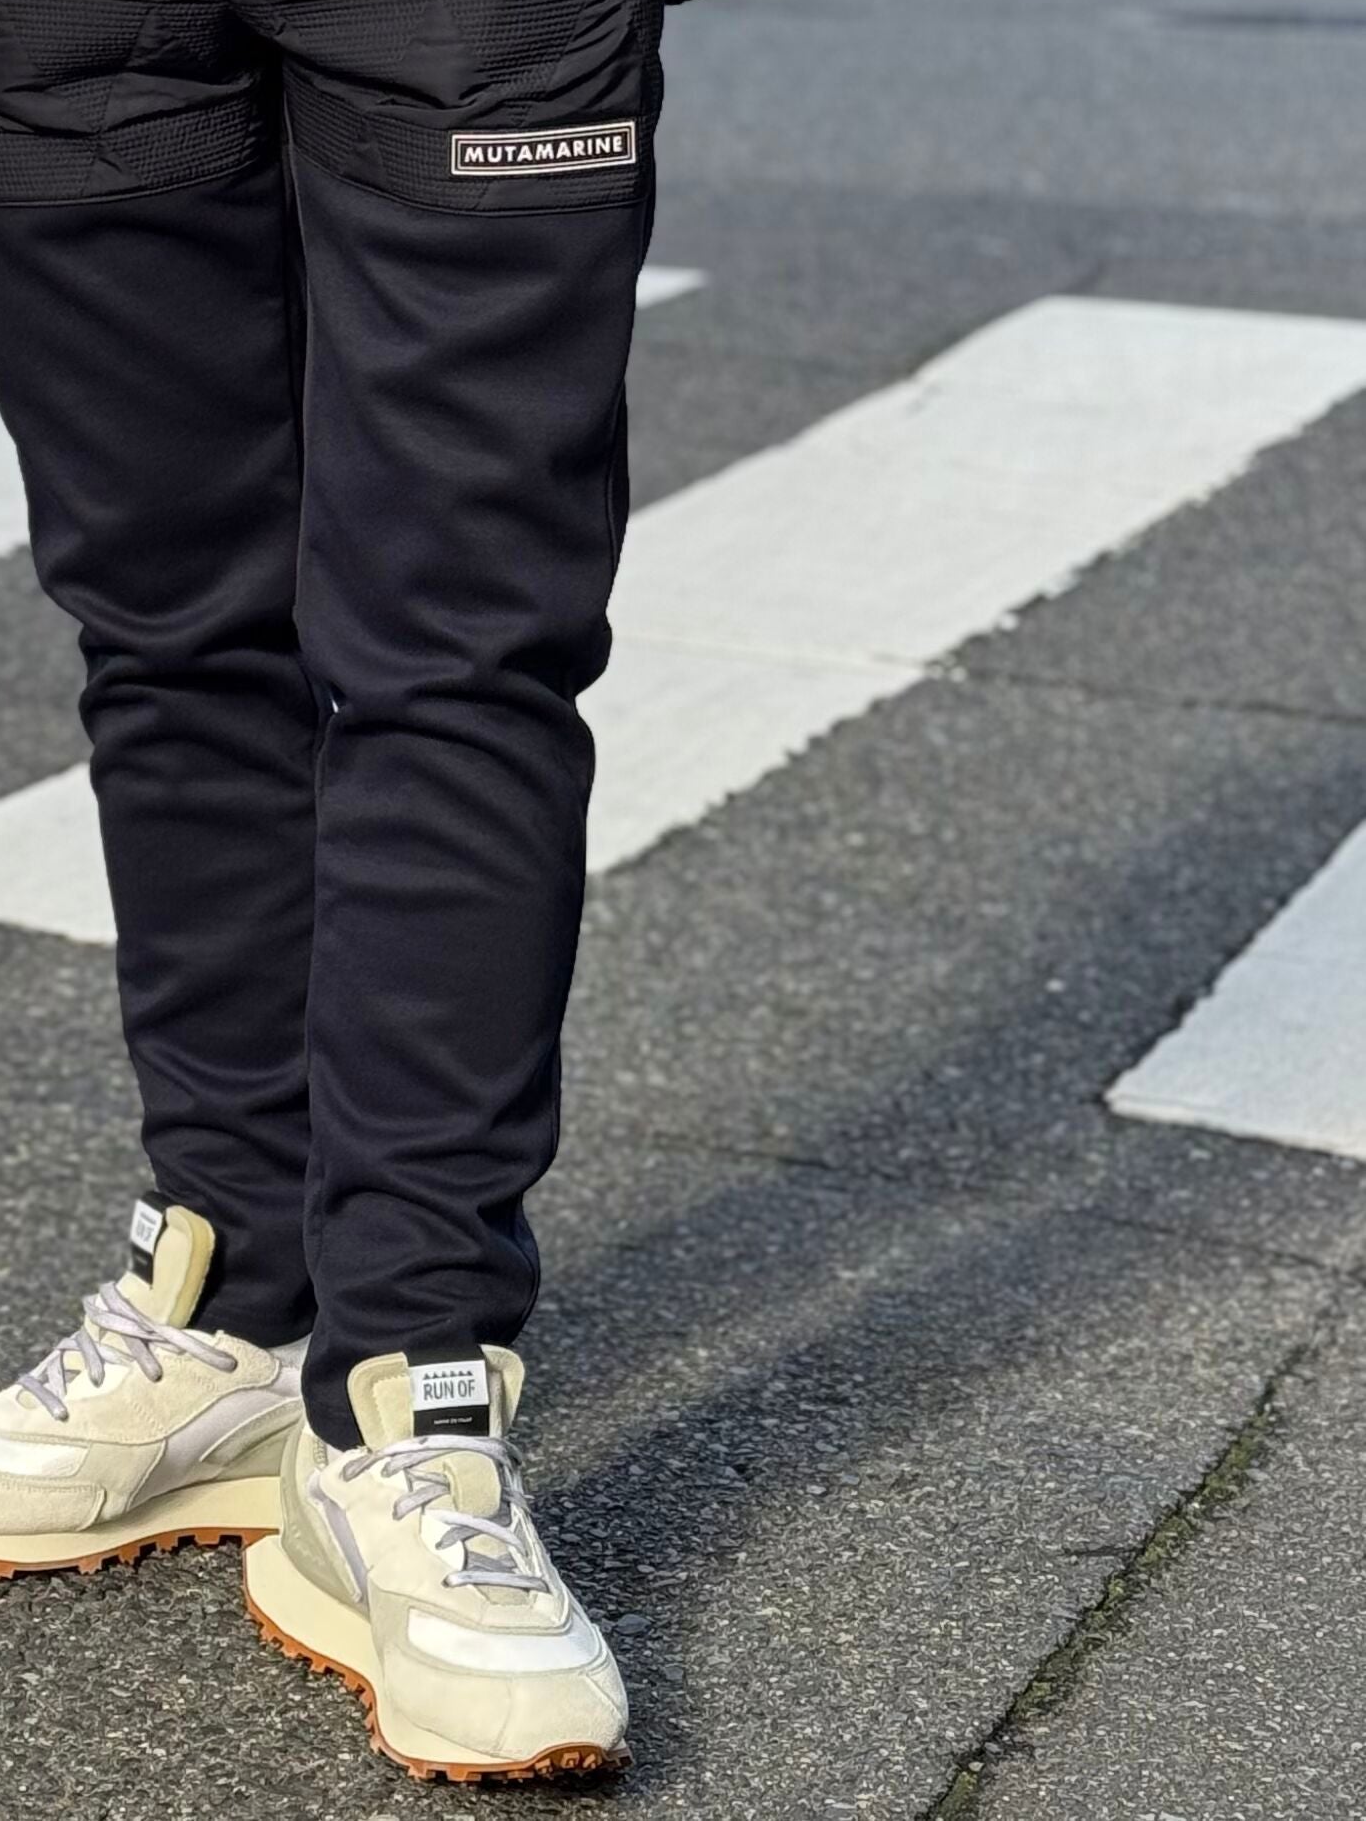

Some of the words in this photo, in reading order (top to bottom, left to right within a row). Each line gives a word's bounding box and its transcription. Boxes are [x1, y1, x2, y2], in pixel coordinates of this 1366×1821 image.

[464, 135, 623, 163] MUTAMARINE
[423, 1381, 454, 1400] RUN
[458, 1379, 475, 1397] OF
